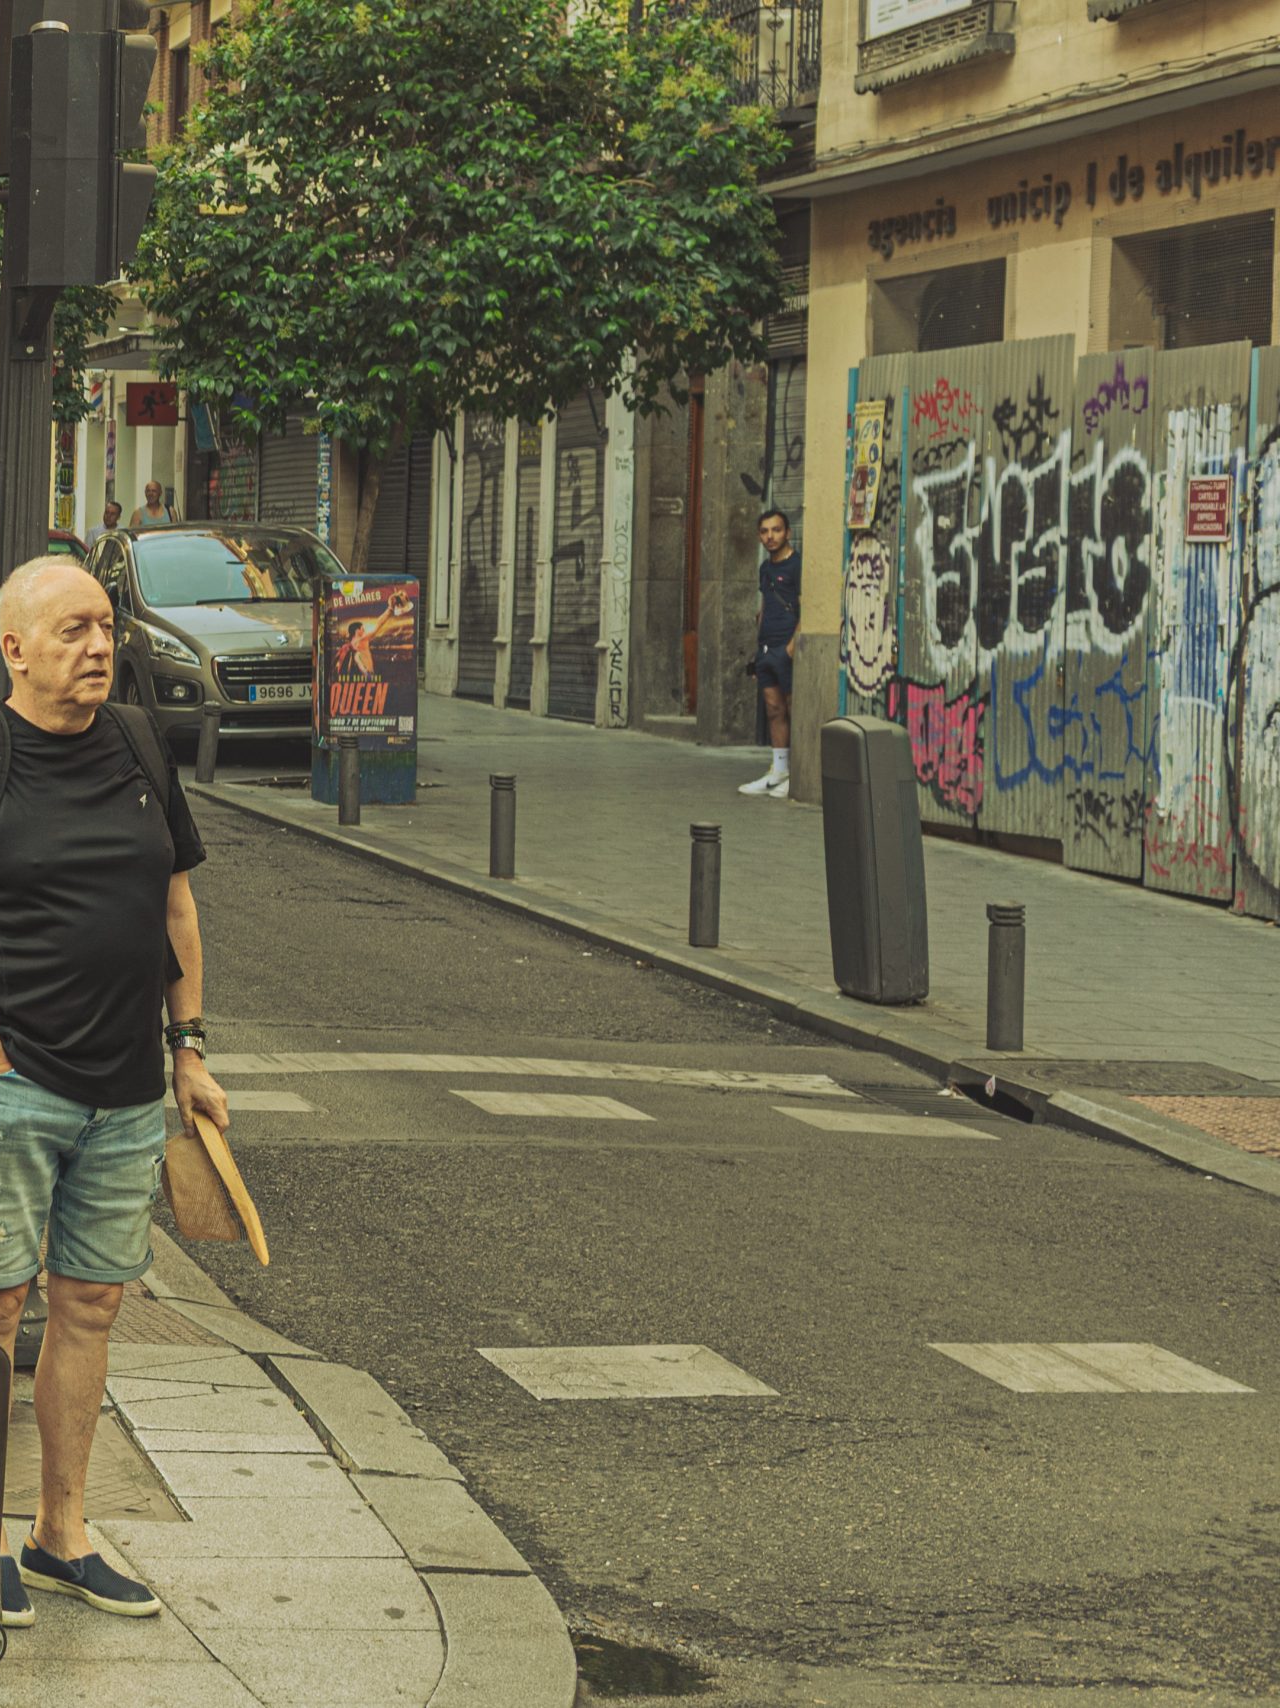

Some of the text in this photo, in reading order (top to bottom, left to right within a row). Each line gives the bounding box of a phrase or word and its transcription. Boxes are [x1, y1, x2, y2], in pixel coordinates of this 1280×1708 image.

[867, 199, 957, 259] agencia
[1109, 154, 1146, 205] de
[1155, 129, 1280, 204] alquiler
[333, 591, 381, 607] DE HENARES
[259, 686, 294, 698] 9696
[329, 682, 389, 717] QUEEN
[352, 718, 359, 726] DE
[360, 718, 397, 727] SEPTIEMBRE
